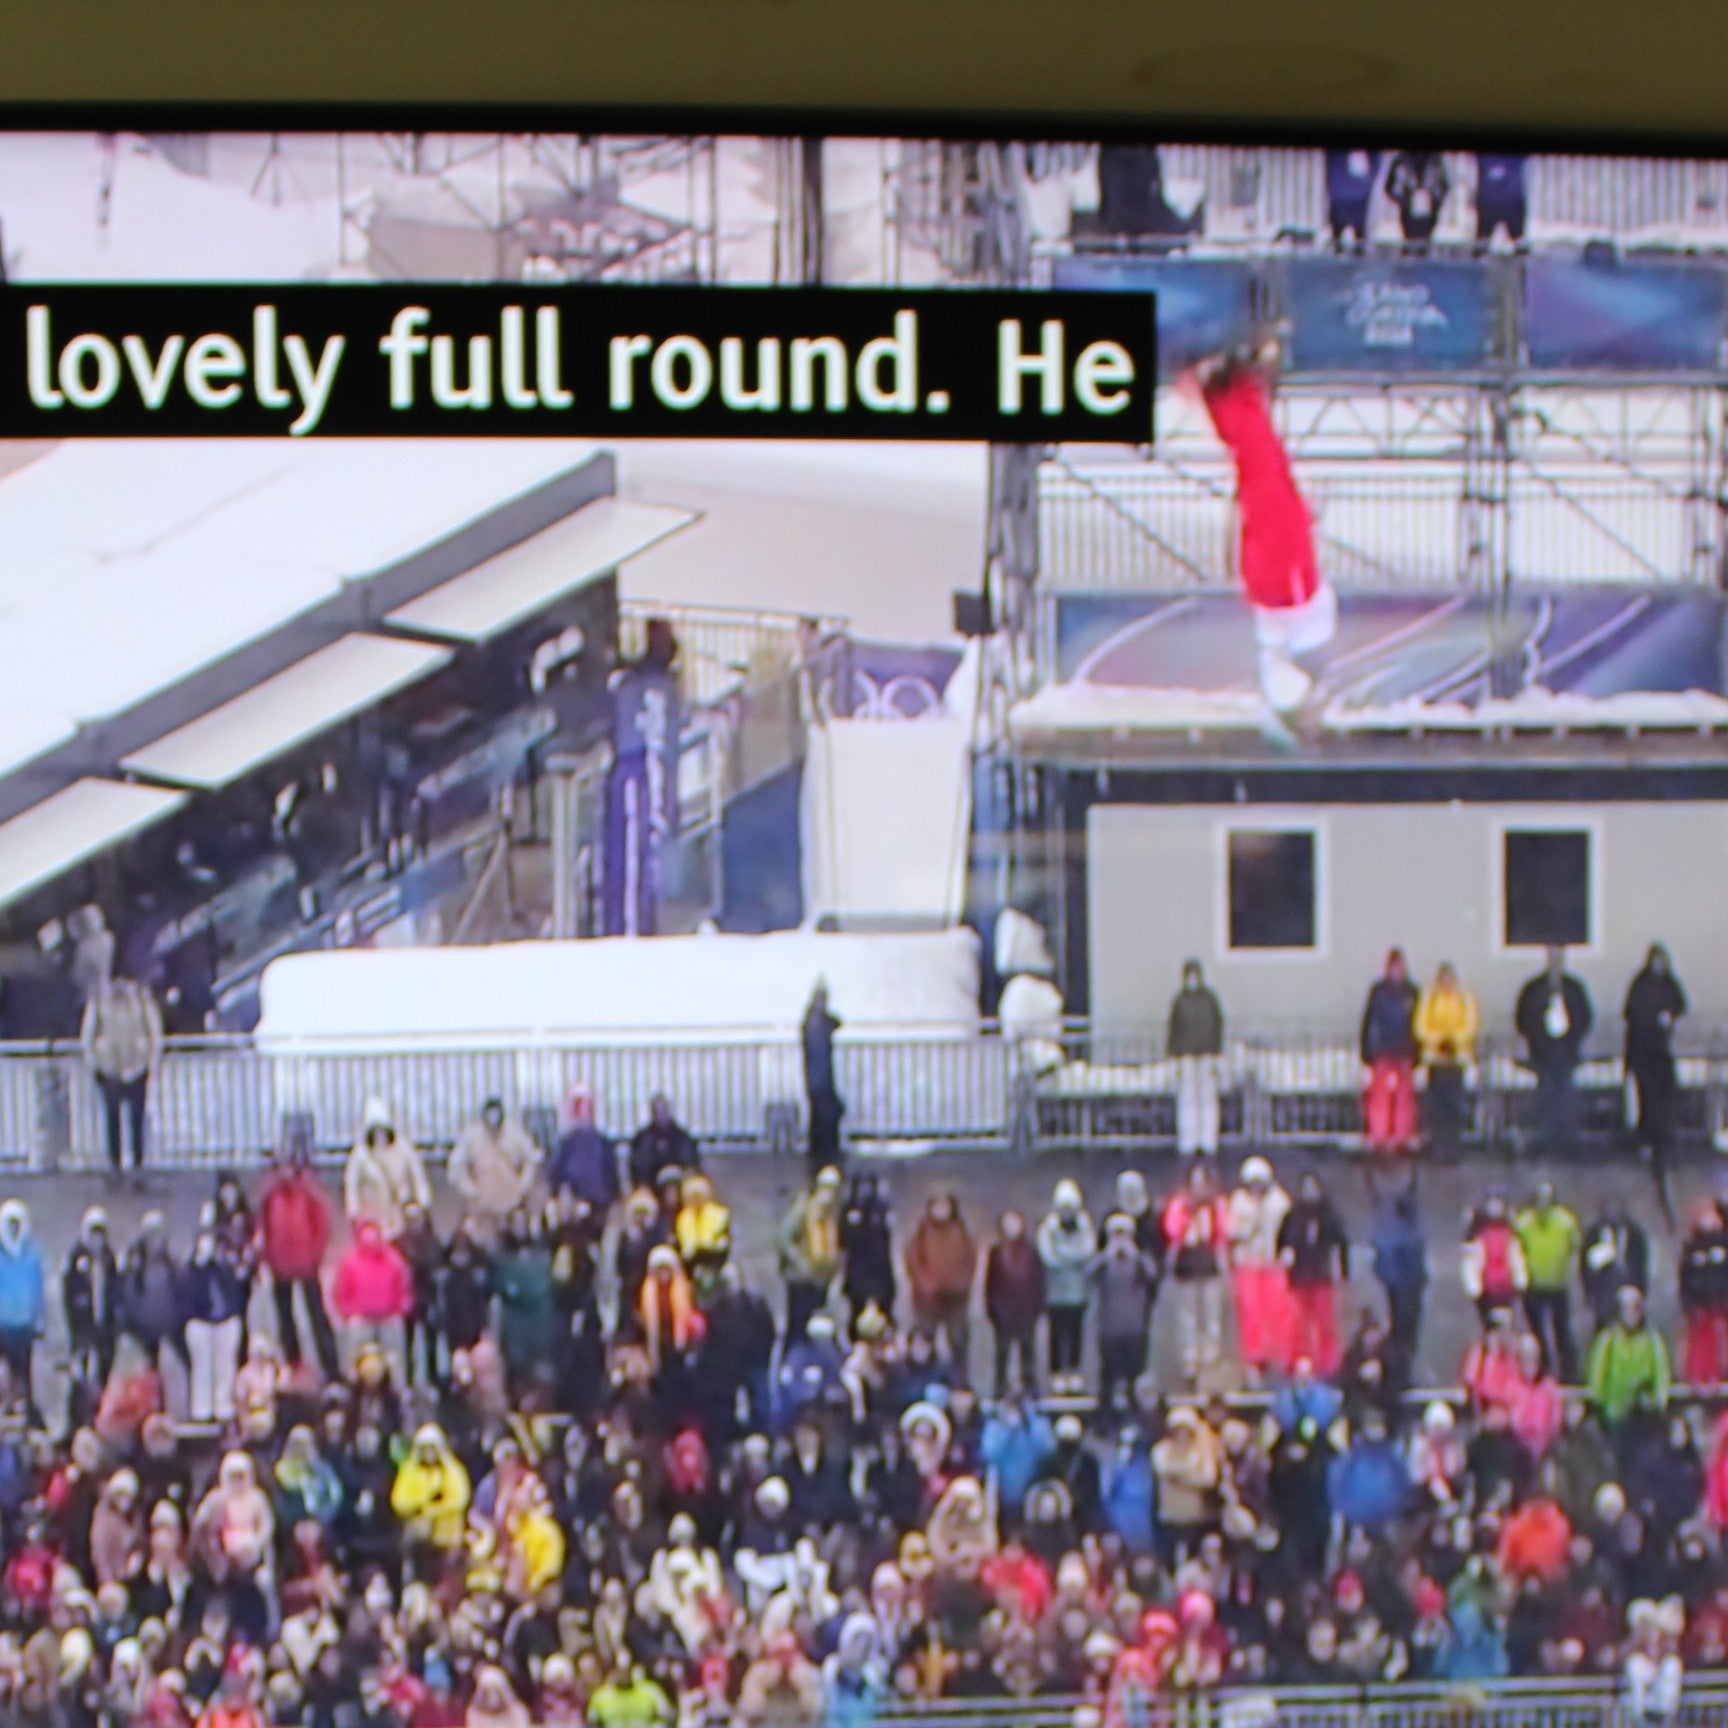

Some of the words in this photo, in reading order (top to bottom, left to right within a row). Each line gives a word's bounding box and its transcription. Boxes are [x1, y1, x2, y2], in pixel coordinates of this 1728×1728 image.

[25, 303, 345, 429] lovely
[378, 304, 574, 409] full
[608, 308, 949, 413] round.
[997, 318, 1135, 414] He
